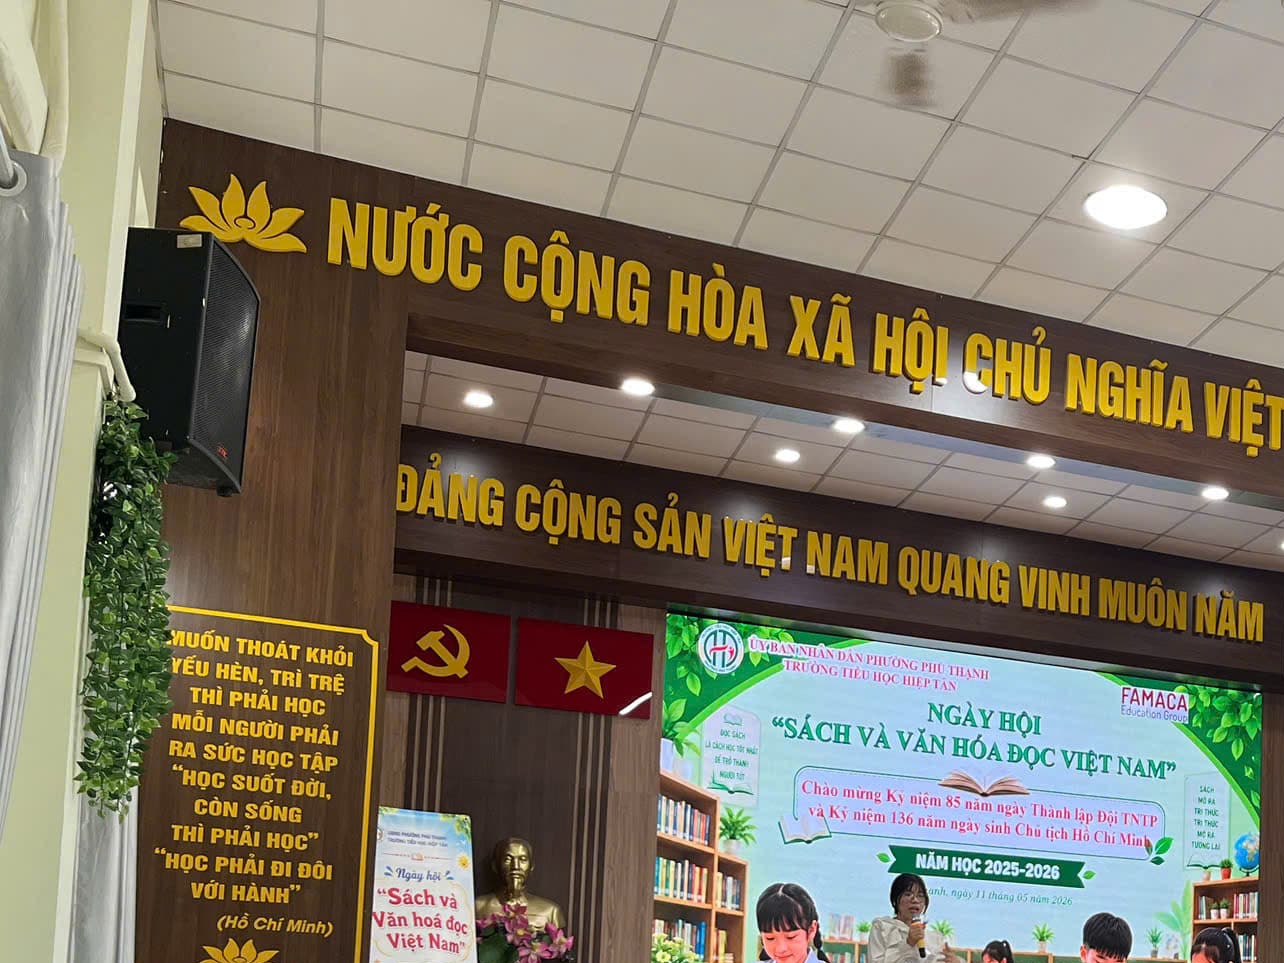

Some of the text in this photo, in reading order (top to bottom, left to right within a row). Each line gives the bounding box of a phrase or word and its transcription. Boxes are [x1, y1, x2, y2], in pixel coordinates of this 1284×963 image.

[327, 198, 483, 290] NƯỚC
[504, 230, 650, 323] CỘNG
[667, 265, 768, 351] HÒA
[788, 295, 856, 367] XÃ
[873, 309, 948, 393] HỘI
[963, 326, 1051, 405] CHỦ
[1065, 353, 1193, 433] NGHĨA
[396, 453, 1264, 643] ĐẢNG CỘNG SẢN VIỆT NAM QUANG VINH MUÔN NĂM
[167, 630, 354, 667] MUỐN THOÁT KHỎI
[770, 640, 796, 654] BAN
[800, 643, 834, 659] NHÂN
[838, 649, 866, 663] DÂN
[866, 654, 918, 671] PHƯỜNG
[948, 665, 989, 680] THẠNH
[171, 655, 345, 695] YẾU HÈN, TRÌ TRỆ
[784, 659, 838, 676] TRƯỜNG
[873, 671, 900, 685] HỌC
[190, 686, 326, 717] THÌ PHẢI HỌC
[1121, 705, 1188, 723] Education Group
[1122, 687, 1188, 712] FAMACA
[172, 710, 339, 746] MỖI NGƯỜI PHẢI
[928, 701, 1041, 738] NGÀY HỘI
[169, 740, 338, 774] RA SỨC HỌC TẬP
[772, 714, 1177, 780] “SÁCH VÀ VĂN HÓA ĐỌC VIỆT NAM”
[172, 764, 331, 800] “HỌC SUỐT ĐỜI,
[194, 799, 302, 823] CÒN SỐNG
[801, 779, 838, 797] Chào
[843, 785, 882, 804] mừng
[910, 792, 942, 810] niệm
[946, 794, 961, 808] 85
[965, 797, 993, 812] năm
[997, 802, 1027, 818] ngày
[1031, 803, 1071, 820] Thành
[1074, 807, 1093, 825] lập
[1097, 809, 1118, 827] Đội
[1122, 812, 1158, 828] TNTP
[172, 823, 319, 852] THÌ PHẢI HỌC”
[808, 805, 824, 817] và
[853, 809, 886, 826] niệm
[891, 811, 914, 826] 136
[918, 815, 946, 829] năm
[950, 818, 981, 835] ngày
[985, 820, 1011, 835] sinh
[1015, 822, 1042, 838] Chủ
[1046, 826, 1069, 842] tịch
[1072, 826, 1091, 843] Hồ
[1094, 831, 1116, 844] Chí
[1119, 832, 1152, 848] Minh
[154, 847, 332, 881] “HỌC PHẢI ĐI ĐÔI
[395, 867, 442, 882] Ngày hội
[916, 851, 1060, 881] NĂM HỌC 2025-2026
[191, 880, 301, 903] VỚI HÀNH”
[377, 887, 458, 909] “Sách và
[976, 890, 986, 898] 11
[216, 912, 333, 938] (Hồ Chí Minh)
[372, 911, 468, 936] Văn hoá đọc
[387, 933, 423, 952] Việt
